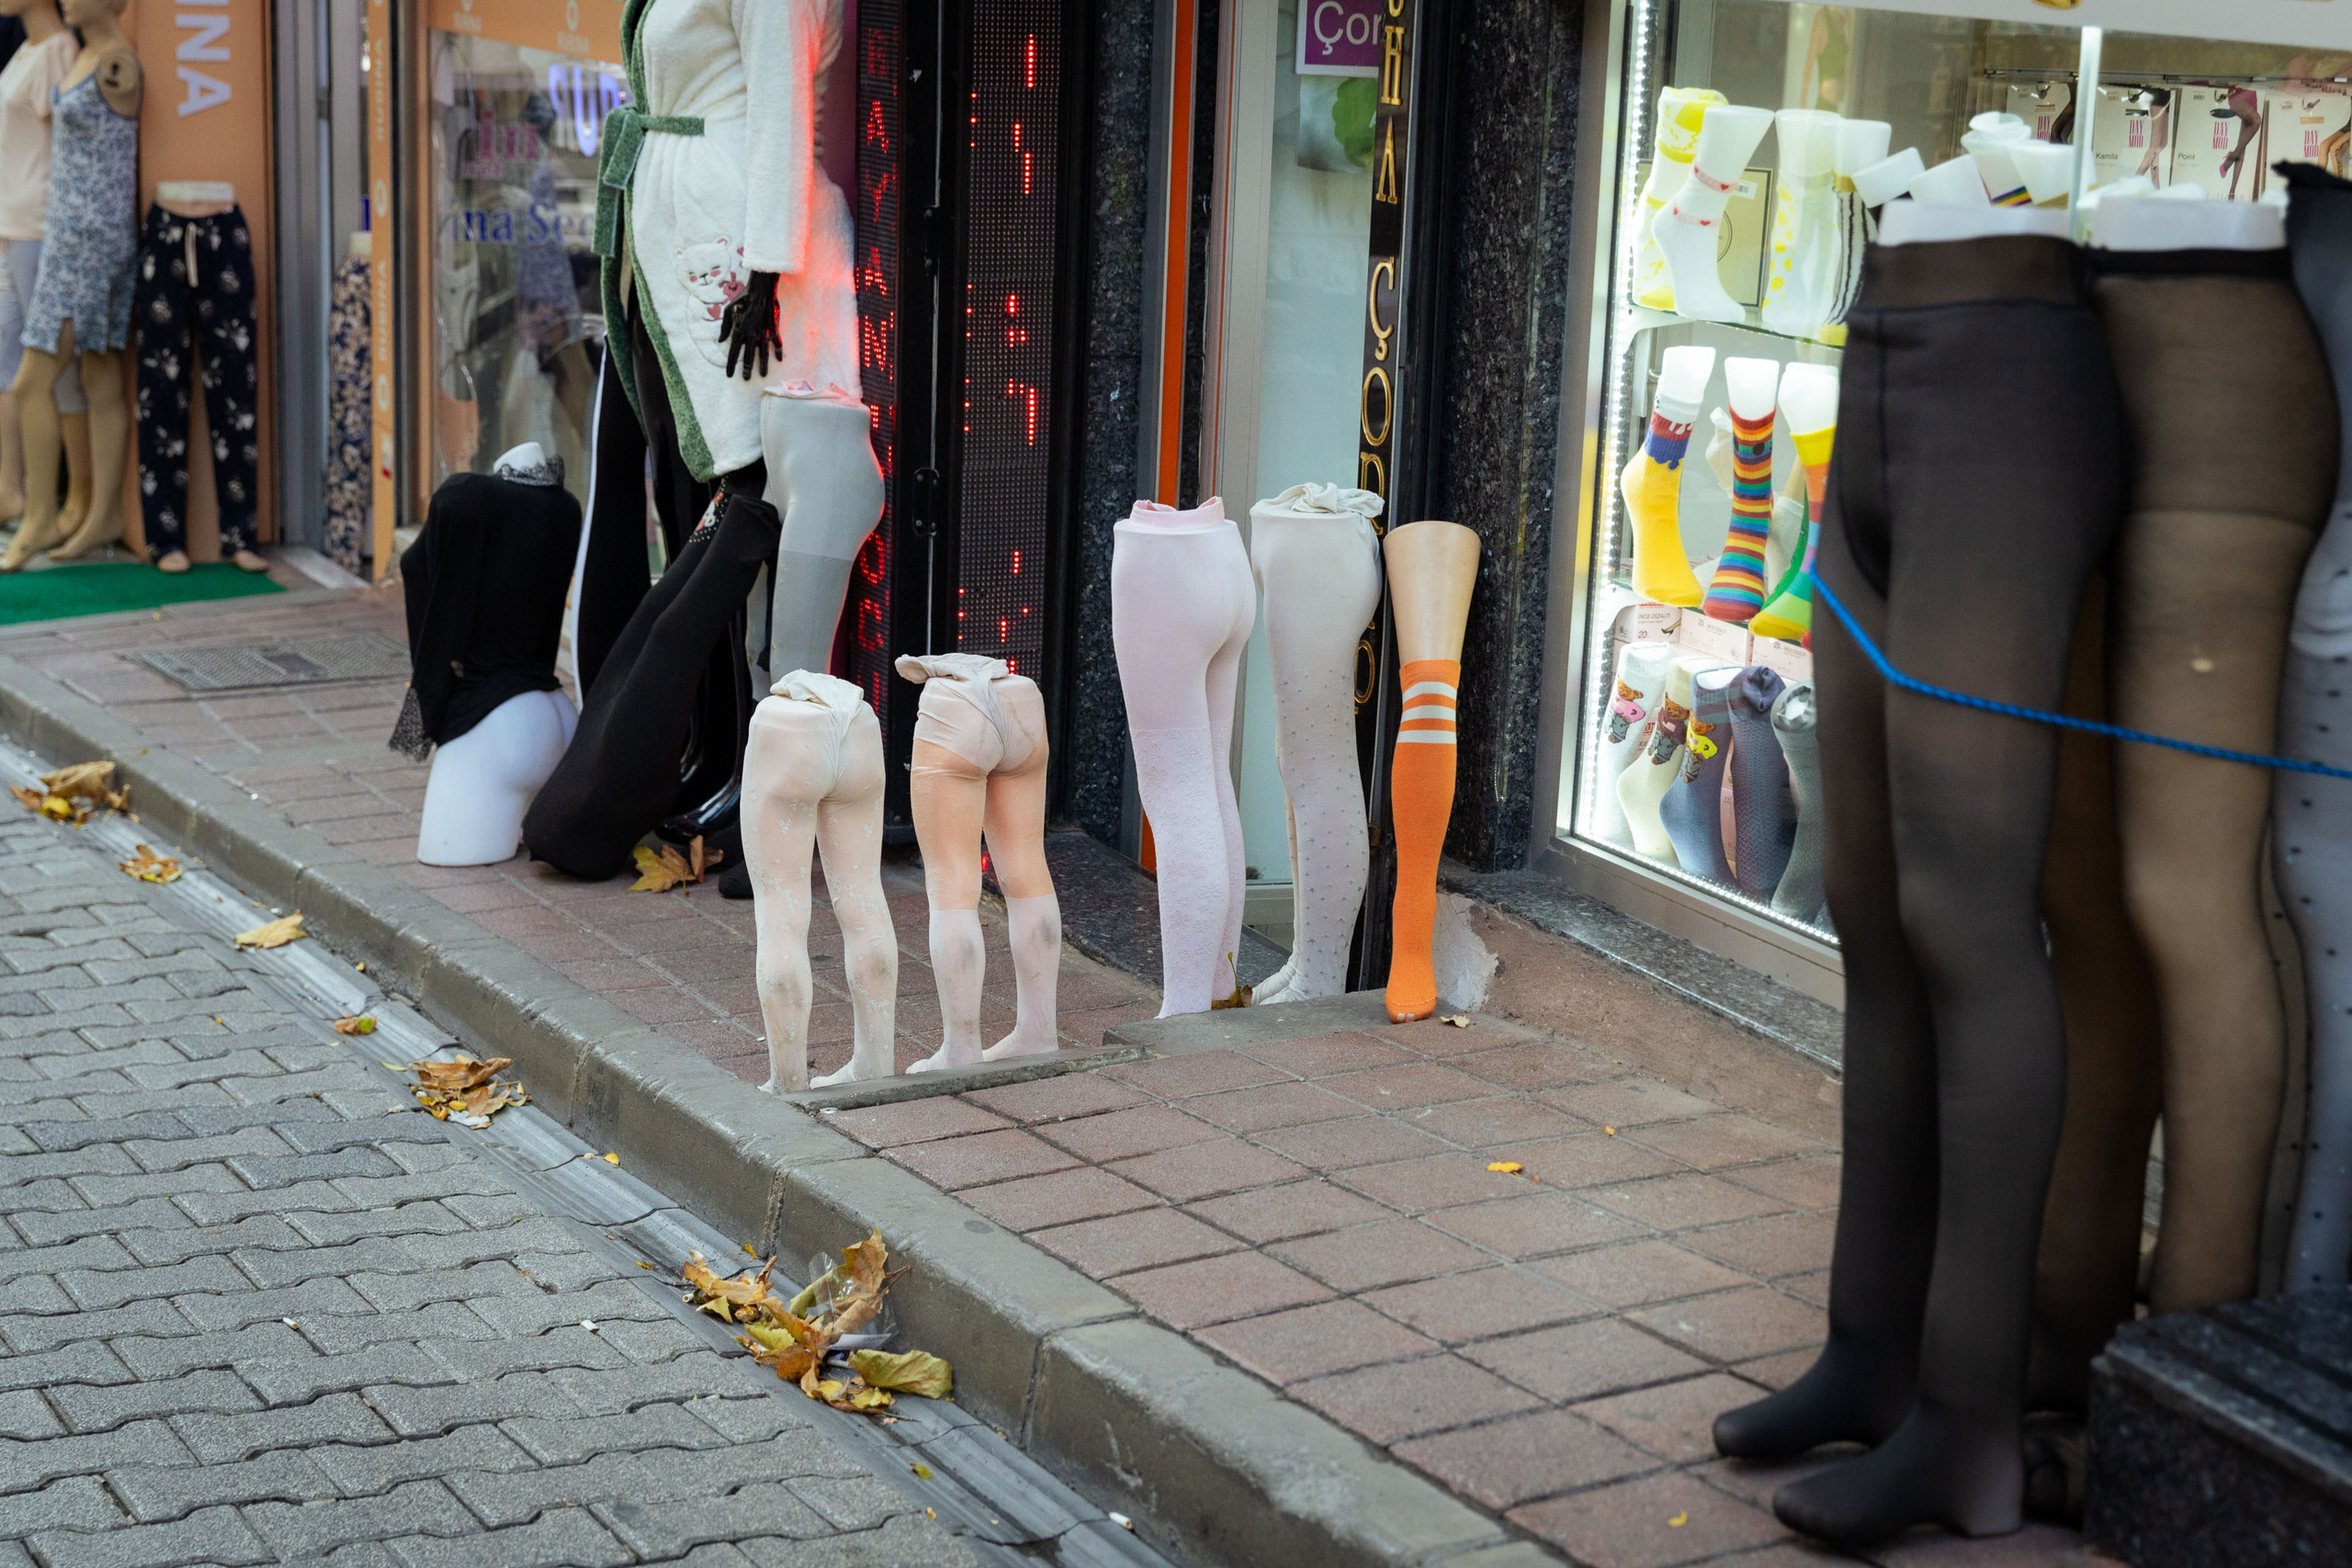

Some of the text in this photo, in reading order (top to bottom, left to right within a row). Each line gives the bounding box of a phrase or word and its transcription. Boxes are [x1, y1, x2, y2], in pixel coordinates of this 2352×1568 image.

[1375, 0, 1406, 204] HA
[2129, 119, 2144, 134] DAY
[2213, 121, 2230, 136] DAY
[2129, 135, 2143, 148] MOD
[2212, 136, 2229, 150] MOD
[2304, 130, 2320, 144] DAY
[2177, 152, 2196, 161] Point
[2303, 144, 2320, 158] MOD
[1637, 630, 1648, 639] 20
